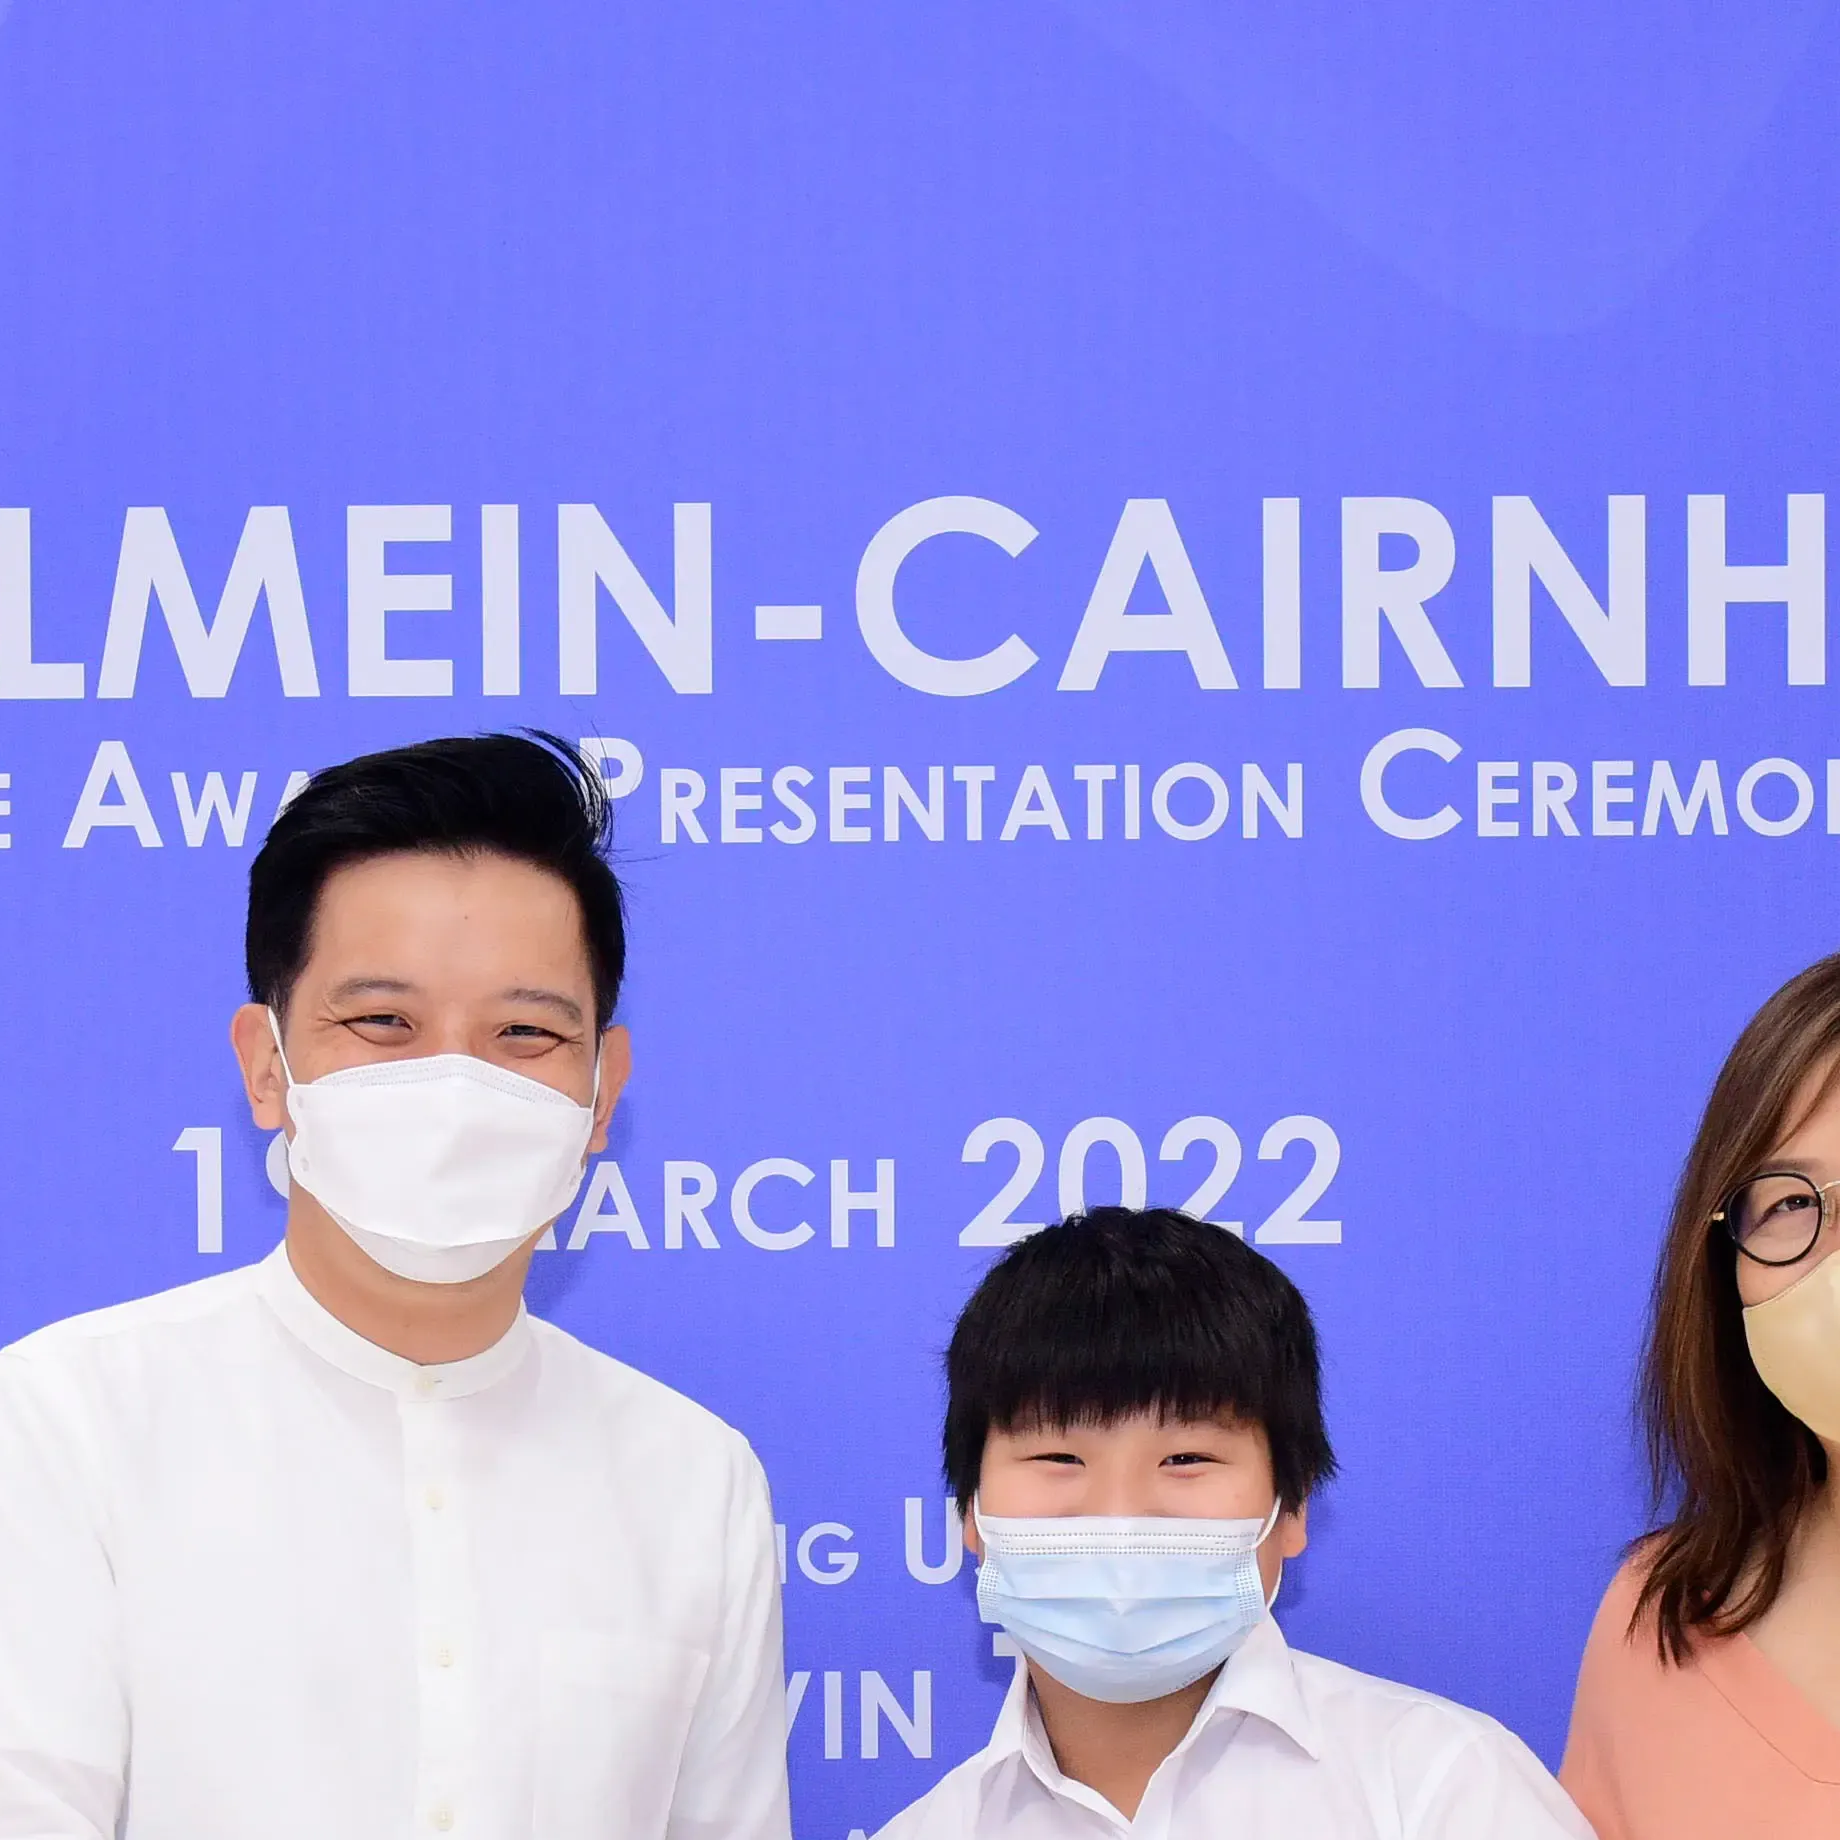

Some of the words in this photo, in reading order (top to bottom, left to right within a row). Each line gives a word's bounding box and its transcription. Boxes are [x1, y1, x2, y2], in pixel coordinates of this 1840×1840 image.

[172, 1126, 290, 1254] 1
[534, 1157, 896, 1251] ARCH
[959, 1114, 1343, 1248] 2022
